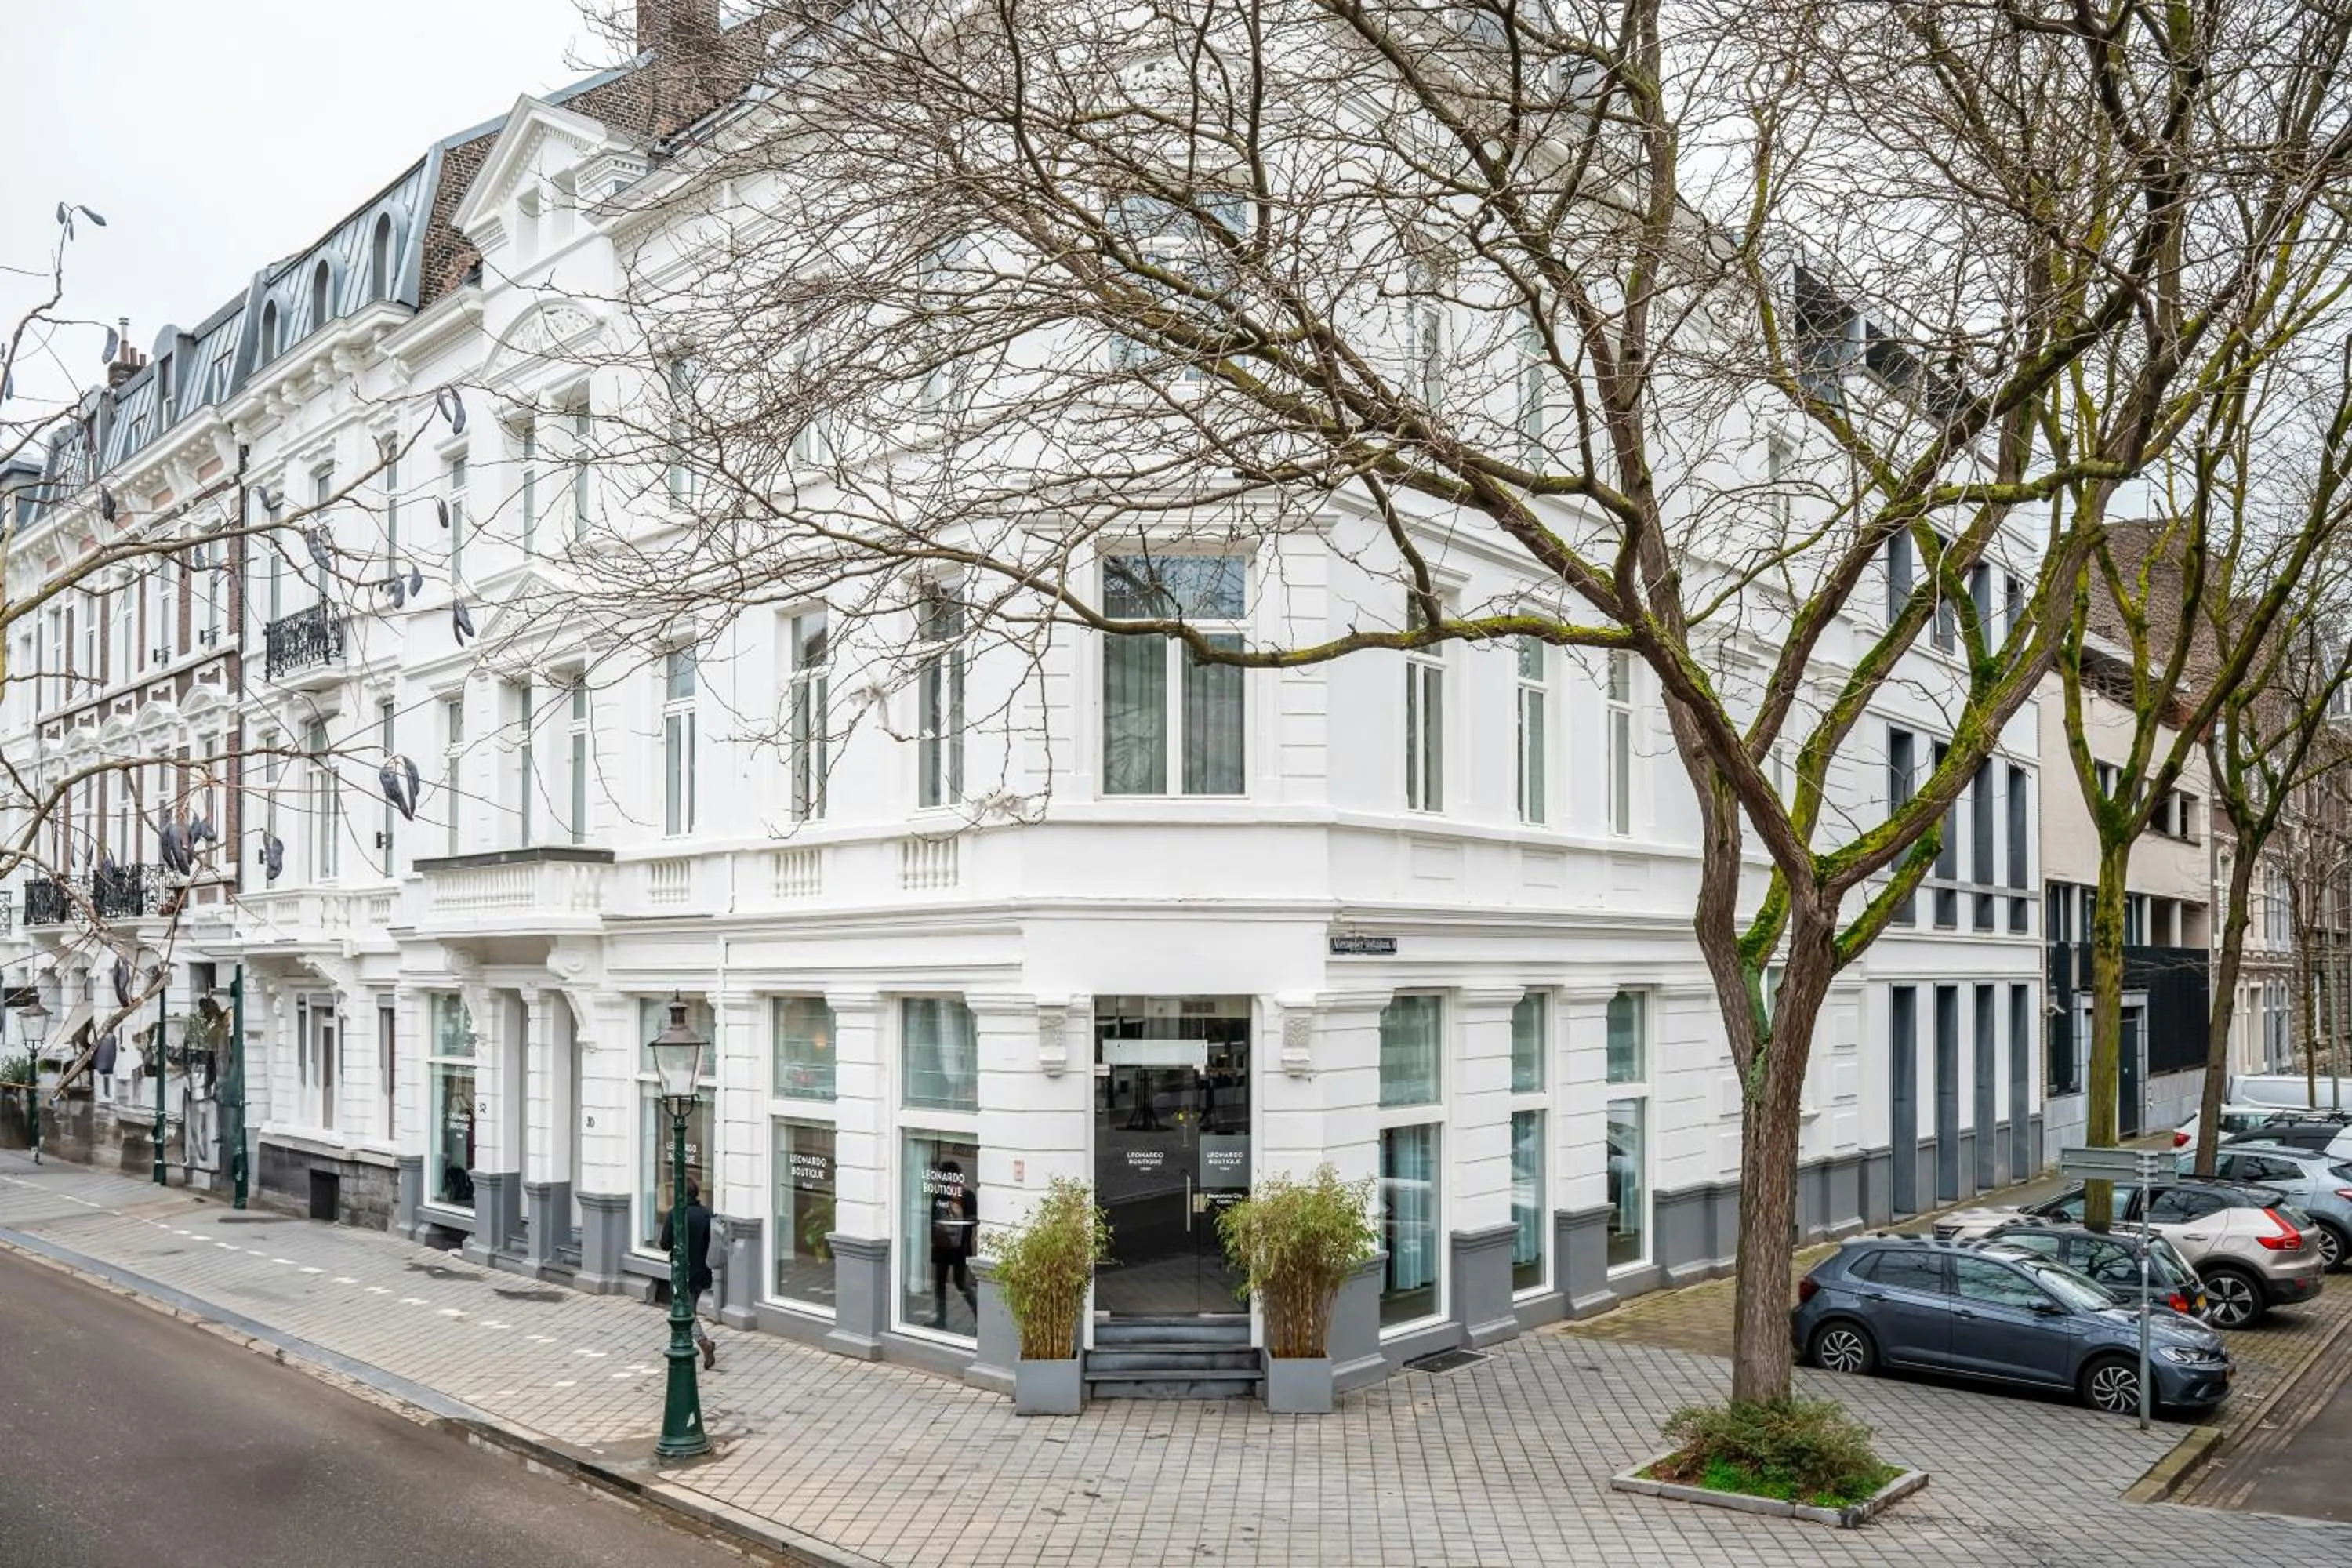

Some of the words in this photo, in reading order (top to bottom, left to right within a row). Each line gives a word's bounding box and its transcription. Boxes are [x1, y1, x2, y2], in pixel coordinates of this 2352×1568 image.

[789, 1153, 827, 1167] LEONARDO
[791, 1166, 826, 1180] BOUTIQUE
[921, 1169, 965, 1184] LEONARDO
[923, 1181, 963, 1197] BOUTIQUE
